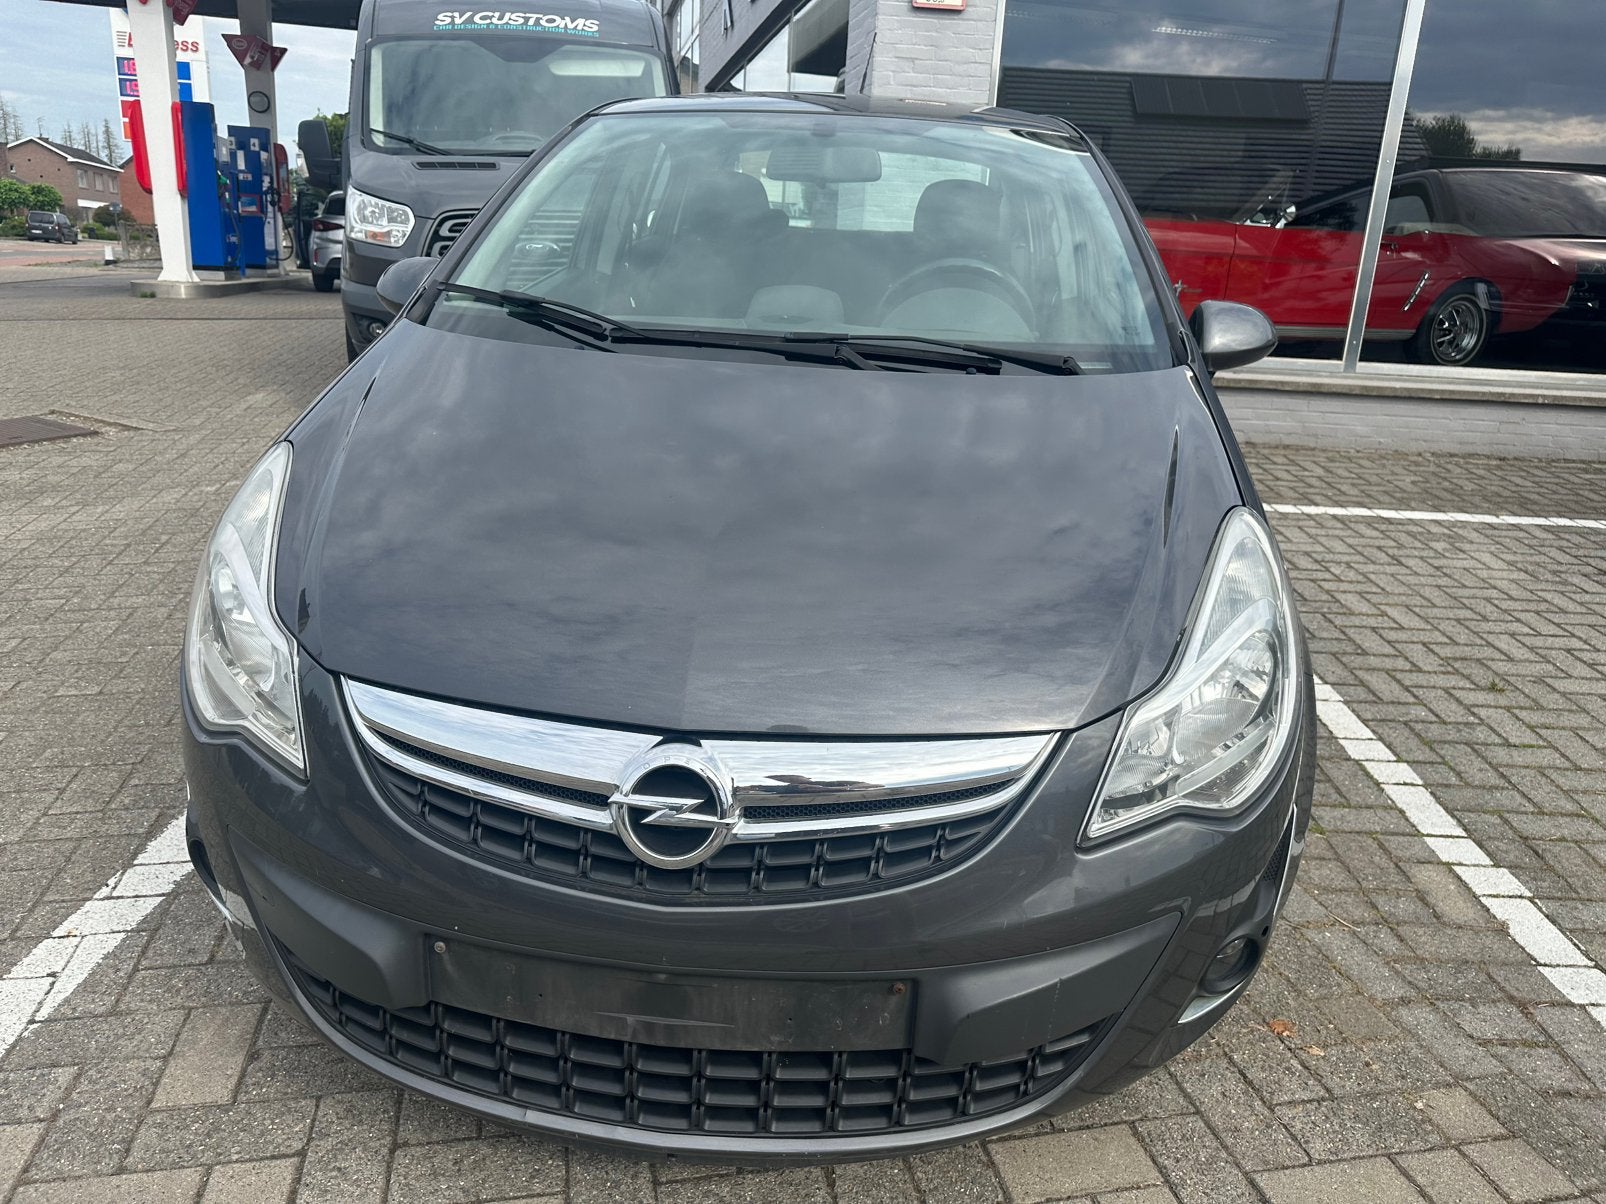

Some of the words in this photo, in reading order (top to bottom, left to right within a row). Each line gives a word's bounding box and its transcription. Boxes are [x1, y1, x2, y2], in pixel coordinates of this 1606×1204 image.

[434, 11, 474, 25] SV
[473, 11, 600, 32] CUSTOMS
[498, 23, 565, 33] CONSTRUCTION
[567, 29, 600, 37] WORKS
